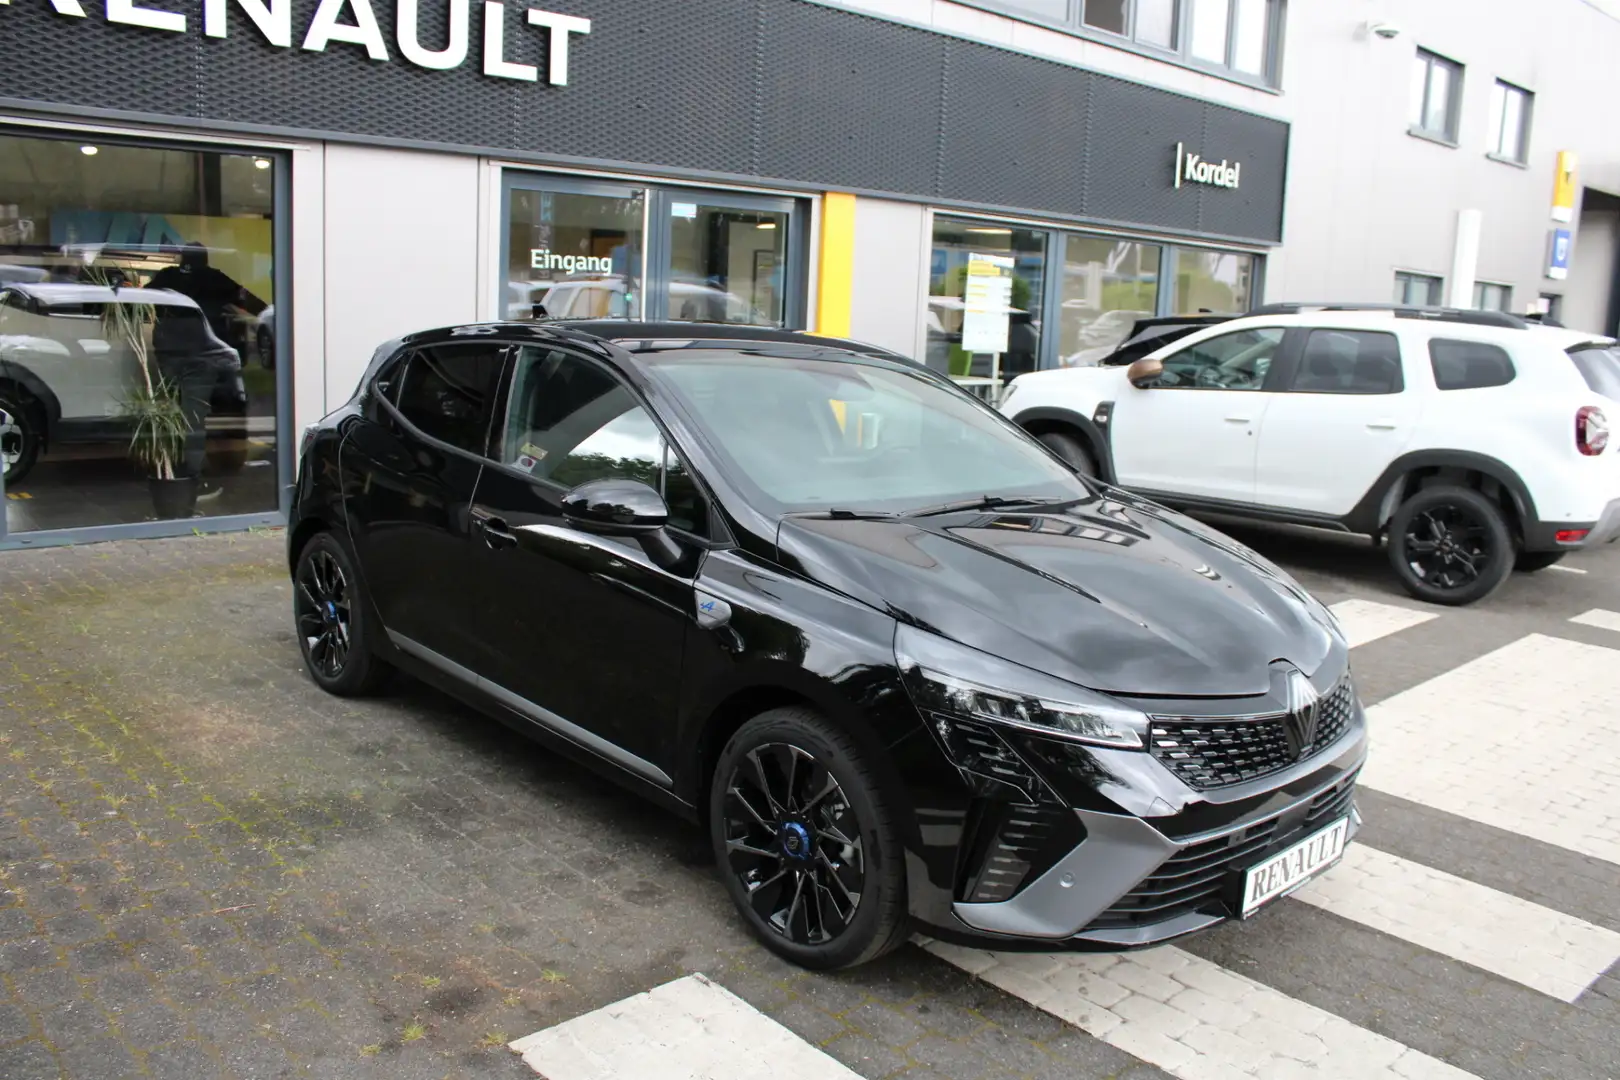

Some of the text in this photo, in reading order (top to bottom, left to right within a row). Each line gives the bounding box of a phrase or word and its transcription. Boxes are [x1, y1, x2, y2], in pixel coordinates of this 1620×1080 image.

[1185, 153, 1240, 188] Kordel
[530, 249, 613, 276] Eingang
[1250, 826, 1342, 903] RENAULT
